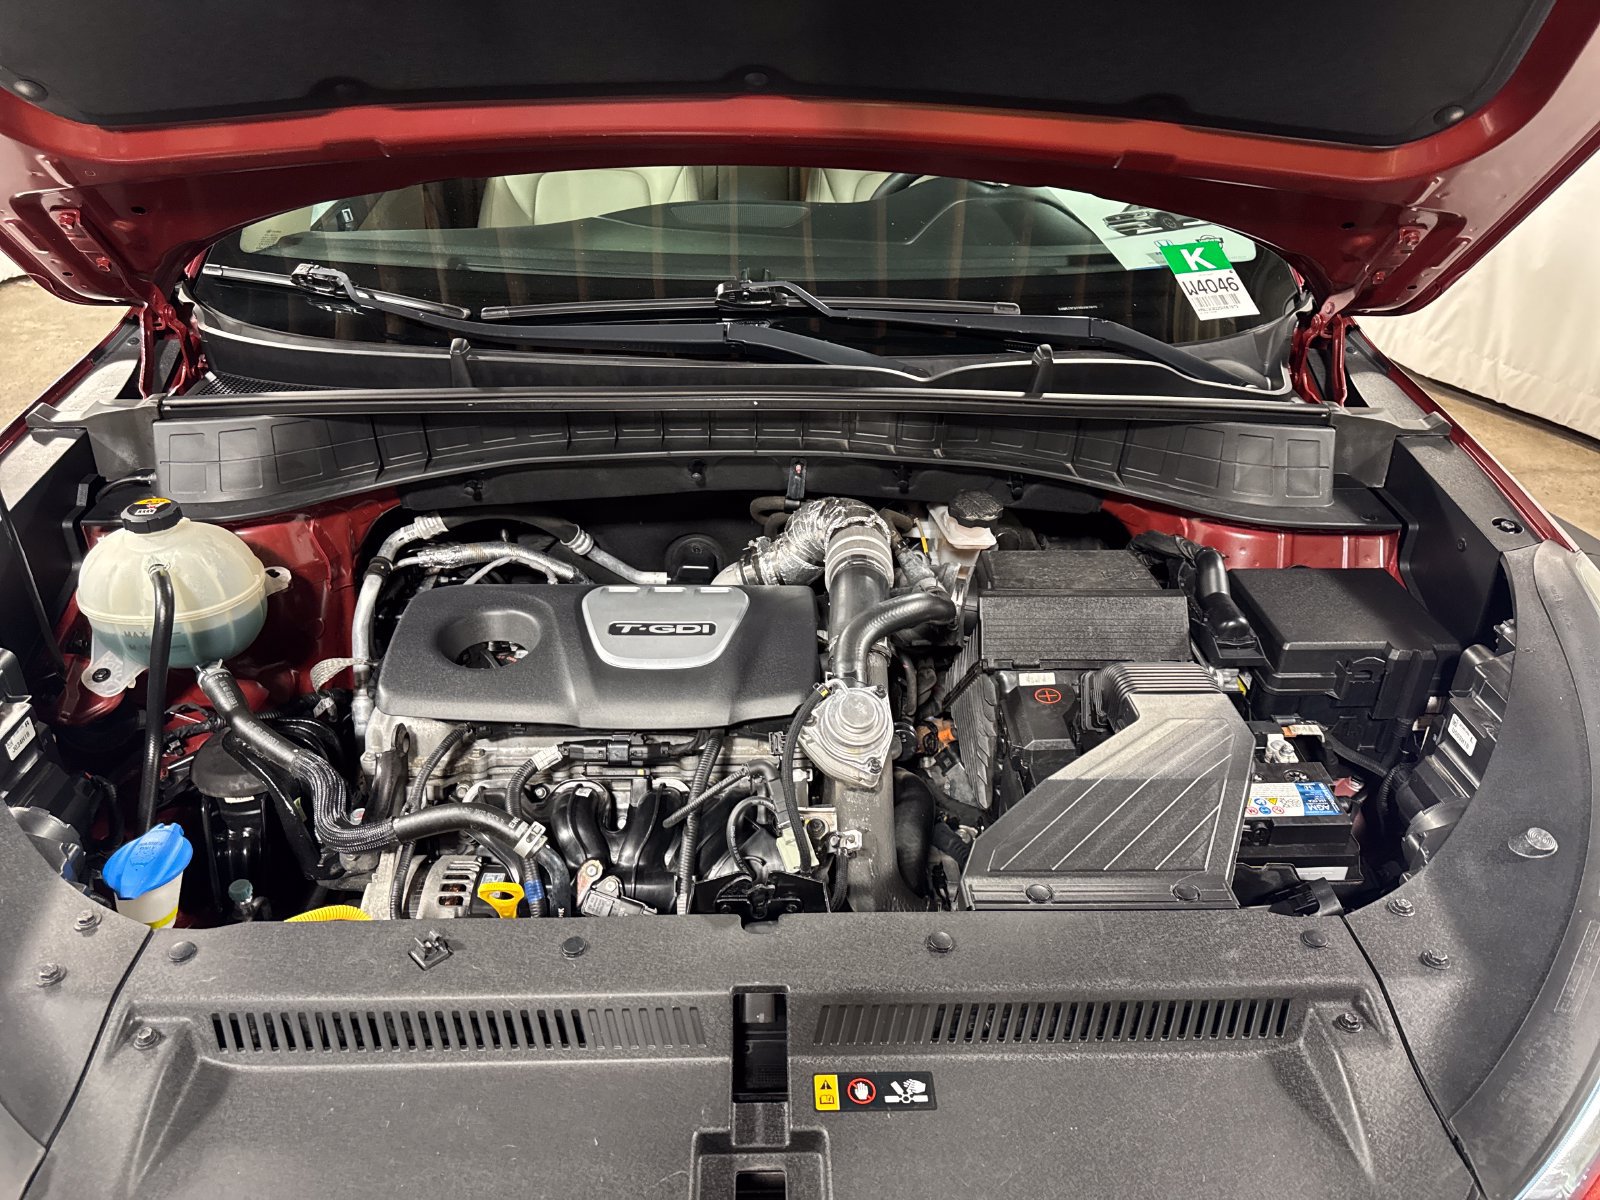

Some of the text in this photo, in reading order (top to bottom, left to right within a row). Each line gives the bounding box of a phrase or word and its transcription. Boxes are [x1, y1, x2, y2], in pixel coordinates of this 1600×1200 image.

[1180, 247, 1217, 271] K
[1182, 277, 1240, 297] W4046
[123, 631, 146, 639] MAX
